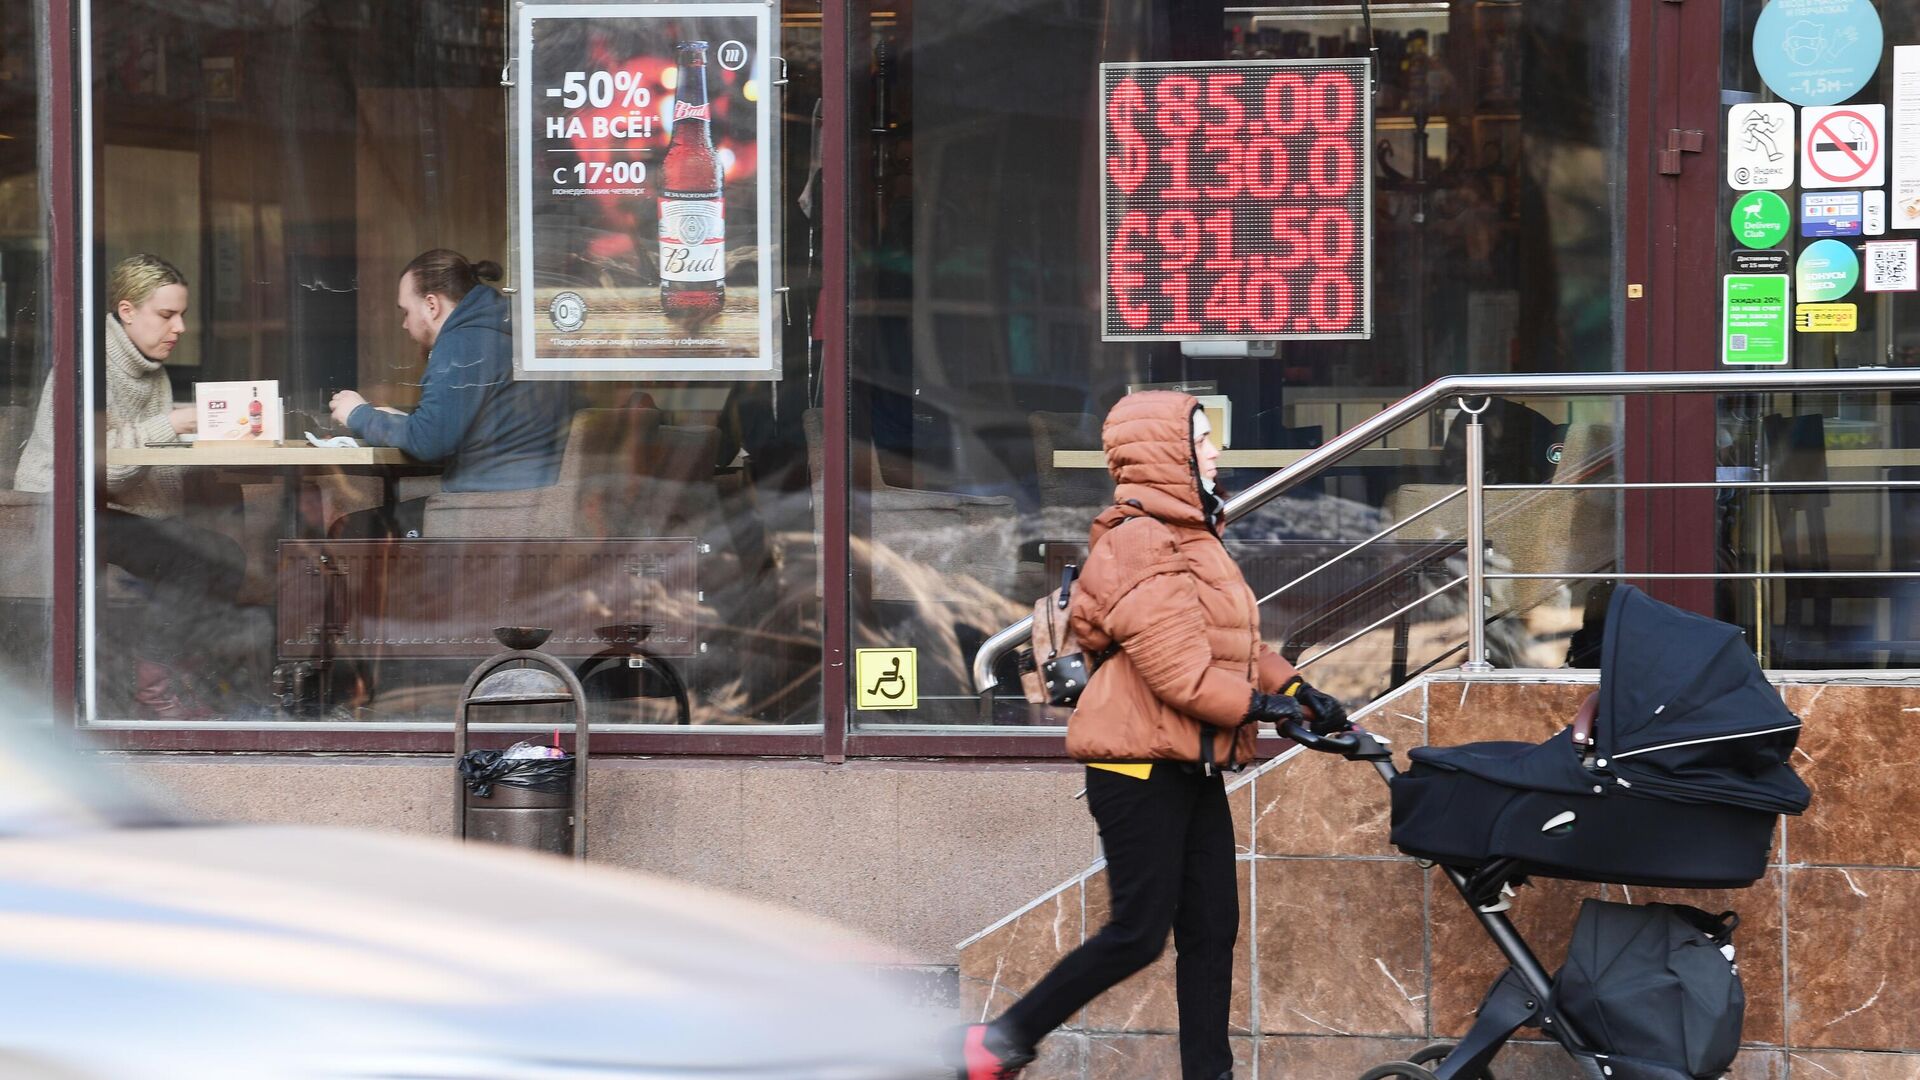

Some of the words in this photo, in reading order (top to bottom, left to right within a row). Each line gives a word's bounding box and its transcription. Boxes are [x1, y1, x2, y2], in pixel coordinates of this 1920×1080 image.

[546, 71, 651, 108] -50%
[675, 102, 706, 119] Bud
[1155, 72, 1356, 135] 85.00
[546, 117, 588, 139] НА
[573, 162, 647, 184] 17:00
[1160, 137, 1355, 200] 130.0
[1753, 167, 1784, 176] Яндекс
[1753, 176, 1768, 185] Еда
[1155, 207, 1355, 270] 91.50
[1744, 222, 1781, 231] Delivery
[663, 246, 719, 274] Bud
[1160, 270, 1355, 333] 140.0
